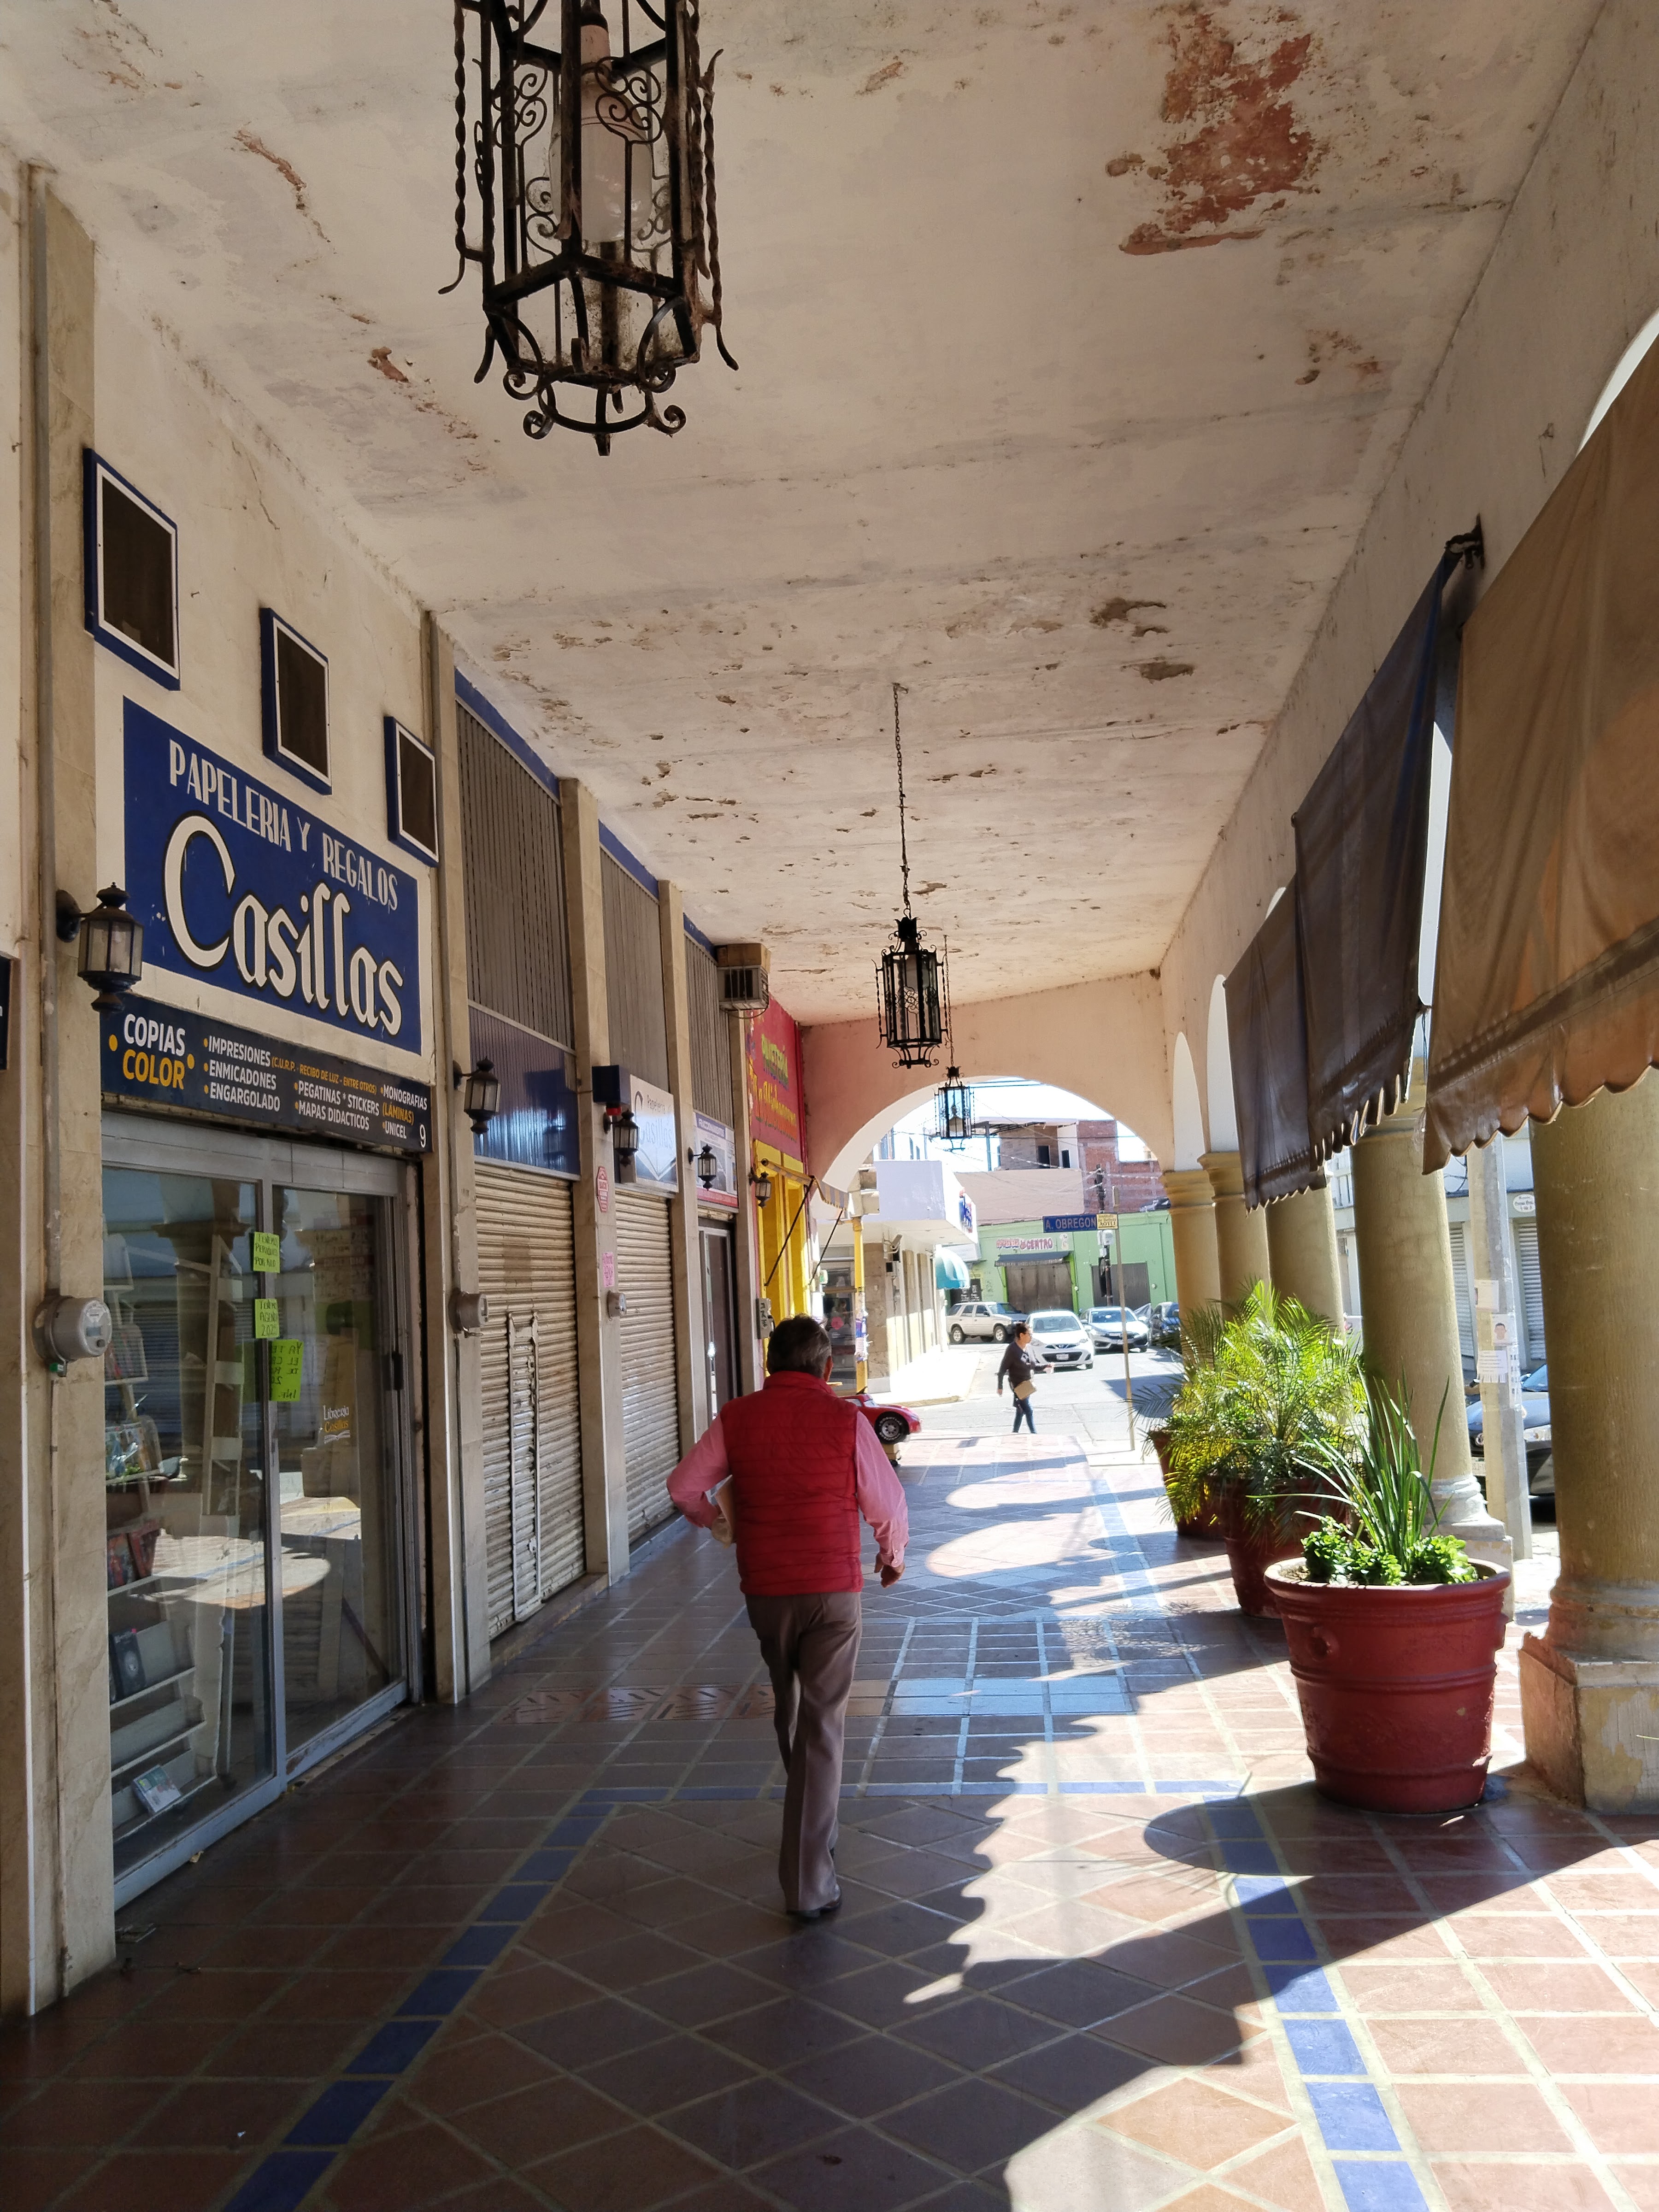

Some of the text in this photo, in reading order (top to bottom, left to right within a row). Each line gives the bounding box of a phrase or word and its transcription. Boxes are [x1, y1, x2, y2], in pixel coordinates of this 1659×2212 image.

[169, 738, 398, 911] PAPELERIA Y REGALOS
[165, 812, 404, 1036] Casillas
[124, 1014, 185, 1056] COPIAS
[123, 1049, 184, 1090] COLOR
[208, 1035, 271, 1067] IMPRESIONES
[300, 1064, 320, 1078] RECIBO
[321, 1070, 328, 1080] DE
[329, 1072, 339, 1083] LUZ
[343, 1077, 358, 1090] ENTRE
[359, 1082, 377, 1095] OTROS)
[210, 1059, 276, 1090] ENMICADONES
[210, 1082, 280, 1112] ENGARGOLADO
[299, 1080, 341, 1105] PEGATINAS
[348, 1094, 380, 1116] STICKERS
[383, 1084, 427, 1111] MONOGRAFIAS
[299, 1100, 369, 1130] MAPAS DIDACTICOS
[385, 1121, 406, 1139] UNICEL
[635, 1091, 673, 1149] Casillas
[420, 1124, 426, 1148] 9
[1046, 1220, 1053, 1230] A.
[1026, 1238, 1053, 1250] CENTRO
